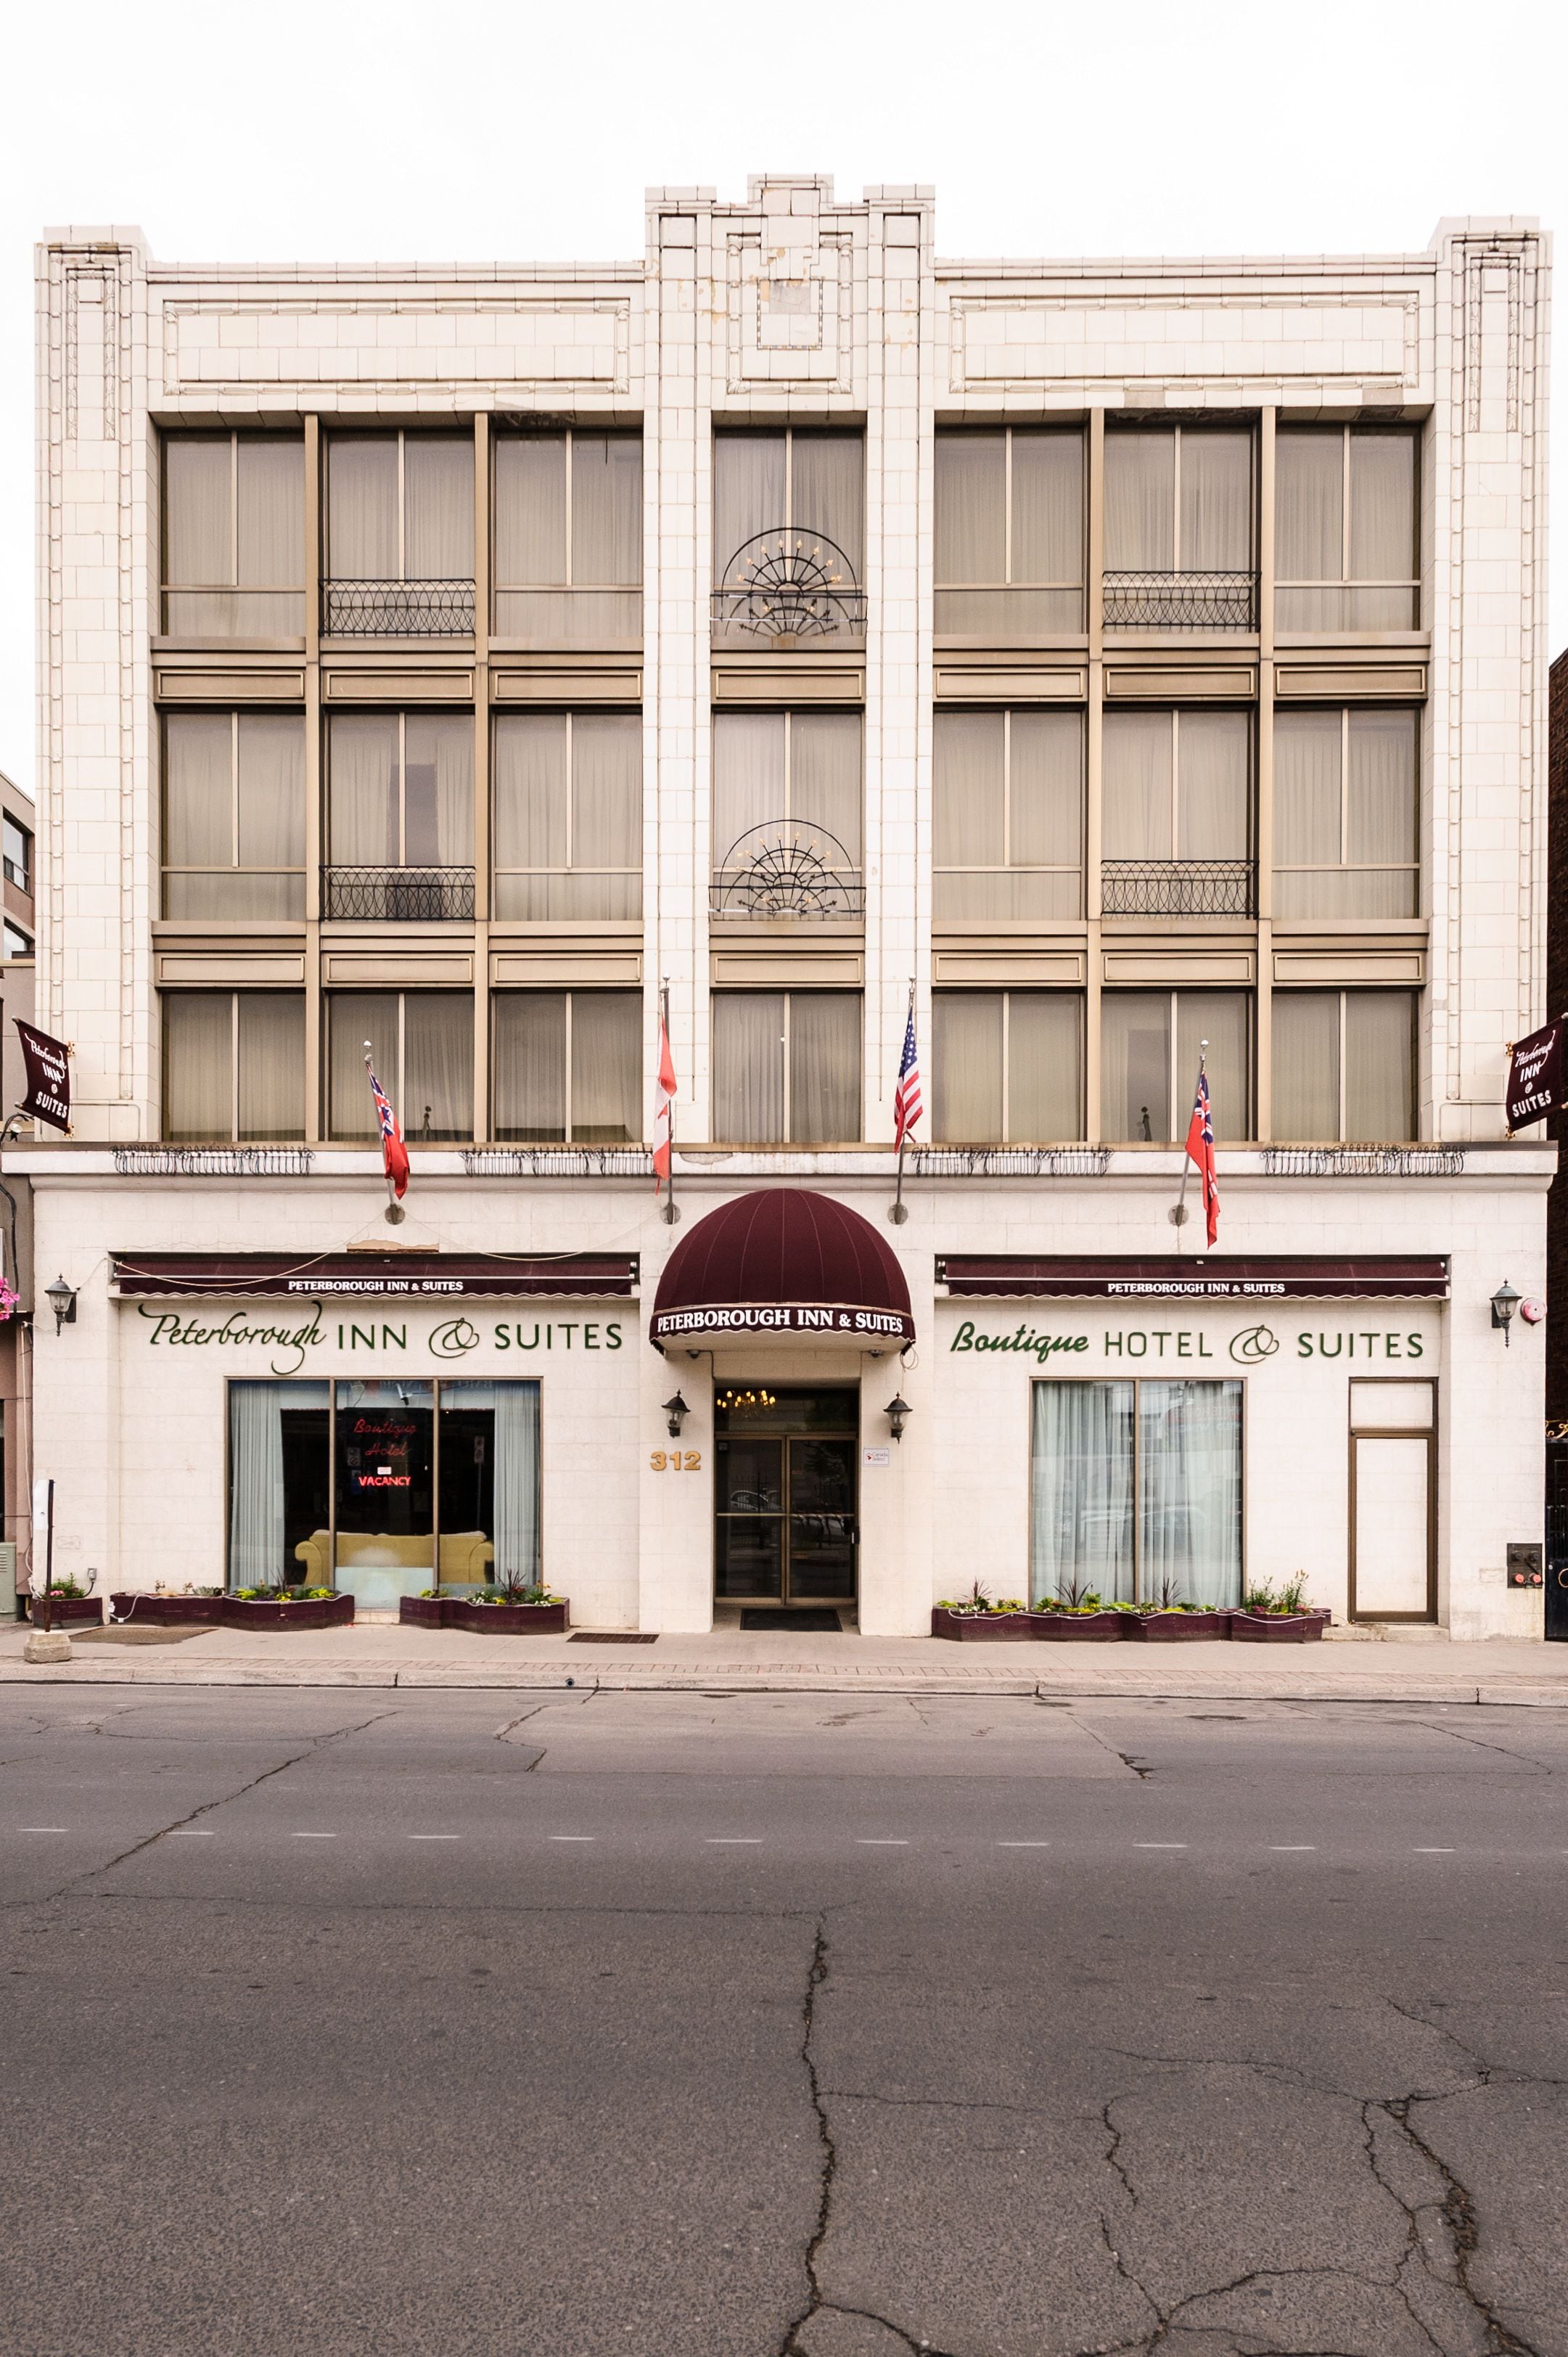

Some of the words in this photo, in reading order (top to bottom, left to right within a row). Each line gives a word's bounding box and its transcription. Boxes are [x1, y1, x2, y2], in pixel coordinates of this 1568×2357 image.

[42, 1062, 62, 1084] INN
[1520, 1061, 1541, 1082] INN
[36, 1091, 67, 1119] SUITES
[1512, 1090, 1551, 1118] SUITES
[288, 1281, 384, 1291] PETERBOROUGH
[387, 1281, 409, 1291] INN
[411, 1282, 419, 1291] &
[422, 1281, 464, 1291] SUITES
[1107, 1283, 1204, 1293] PETERBOROUGH
[1207, 1283, 1230, 1293] INN
[1232, 1284, 1241, 1293] &
[1243, 1283, 1285, 1293] SUITES
[657, 1309, 791, 1333] PETERBOROUGH
[797, 1309, 834, 1327] INN
[839, 1313, 852, 1327] &
[855, 1312, 903, 1333] SUITES
[138, 1300, 327, 1374] Peterborough
[338, 1324, 407, 1350] INN
[429, 1317, 480, 1359] &
[495, 1323, 623, 1350] SUITES
[950, 1321, 1089, 1364] Boutique
[1105, 1332, 1213, 1357] HOTEL
[1229, 1324, 1280, 1364] &
[1298, 1332, 1424, 1358] SUITES
[353, 1418, 417, 1437] Boutique
[364, 1443, 411, 1456] Hotel
[650, 1451, 702, 1471] 312
[358, 1475, 411, 1487] VACANCY
